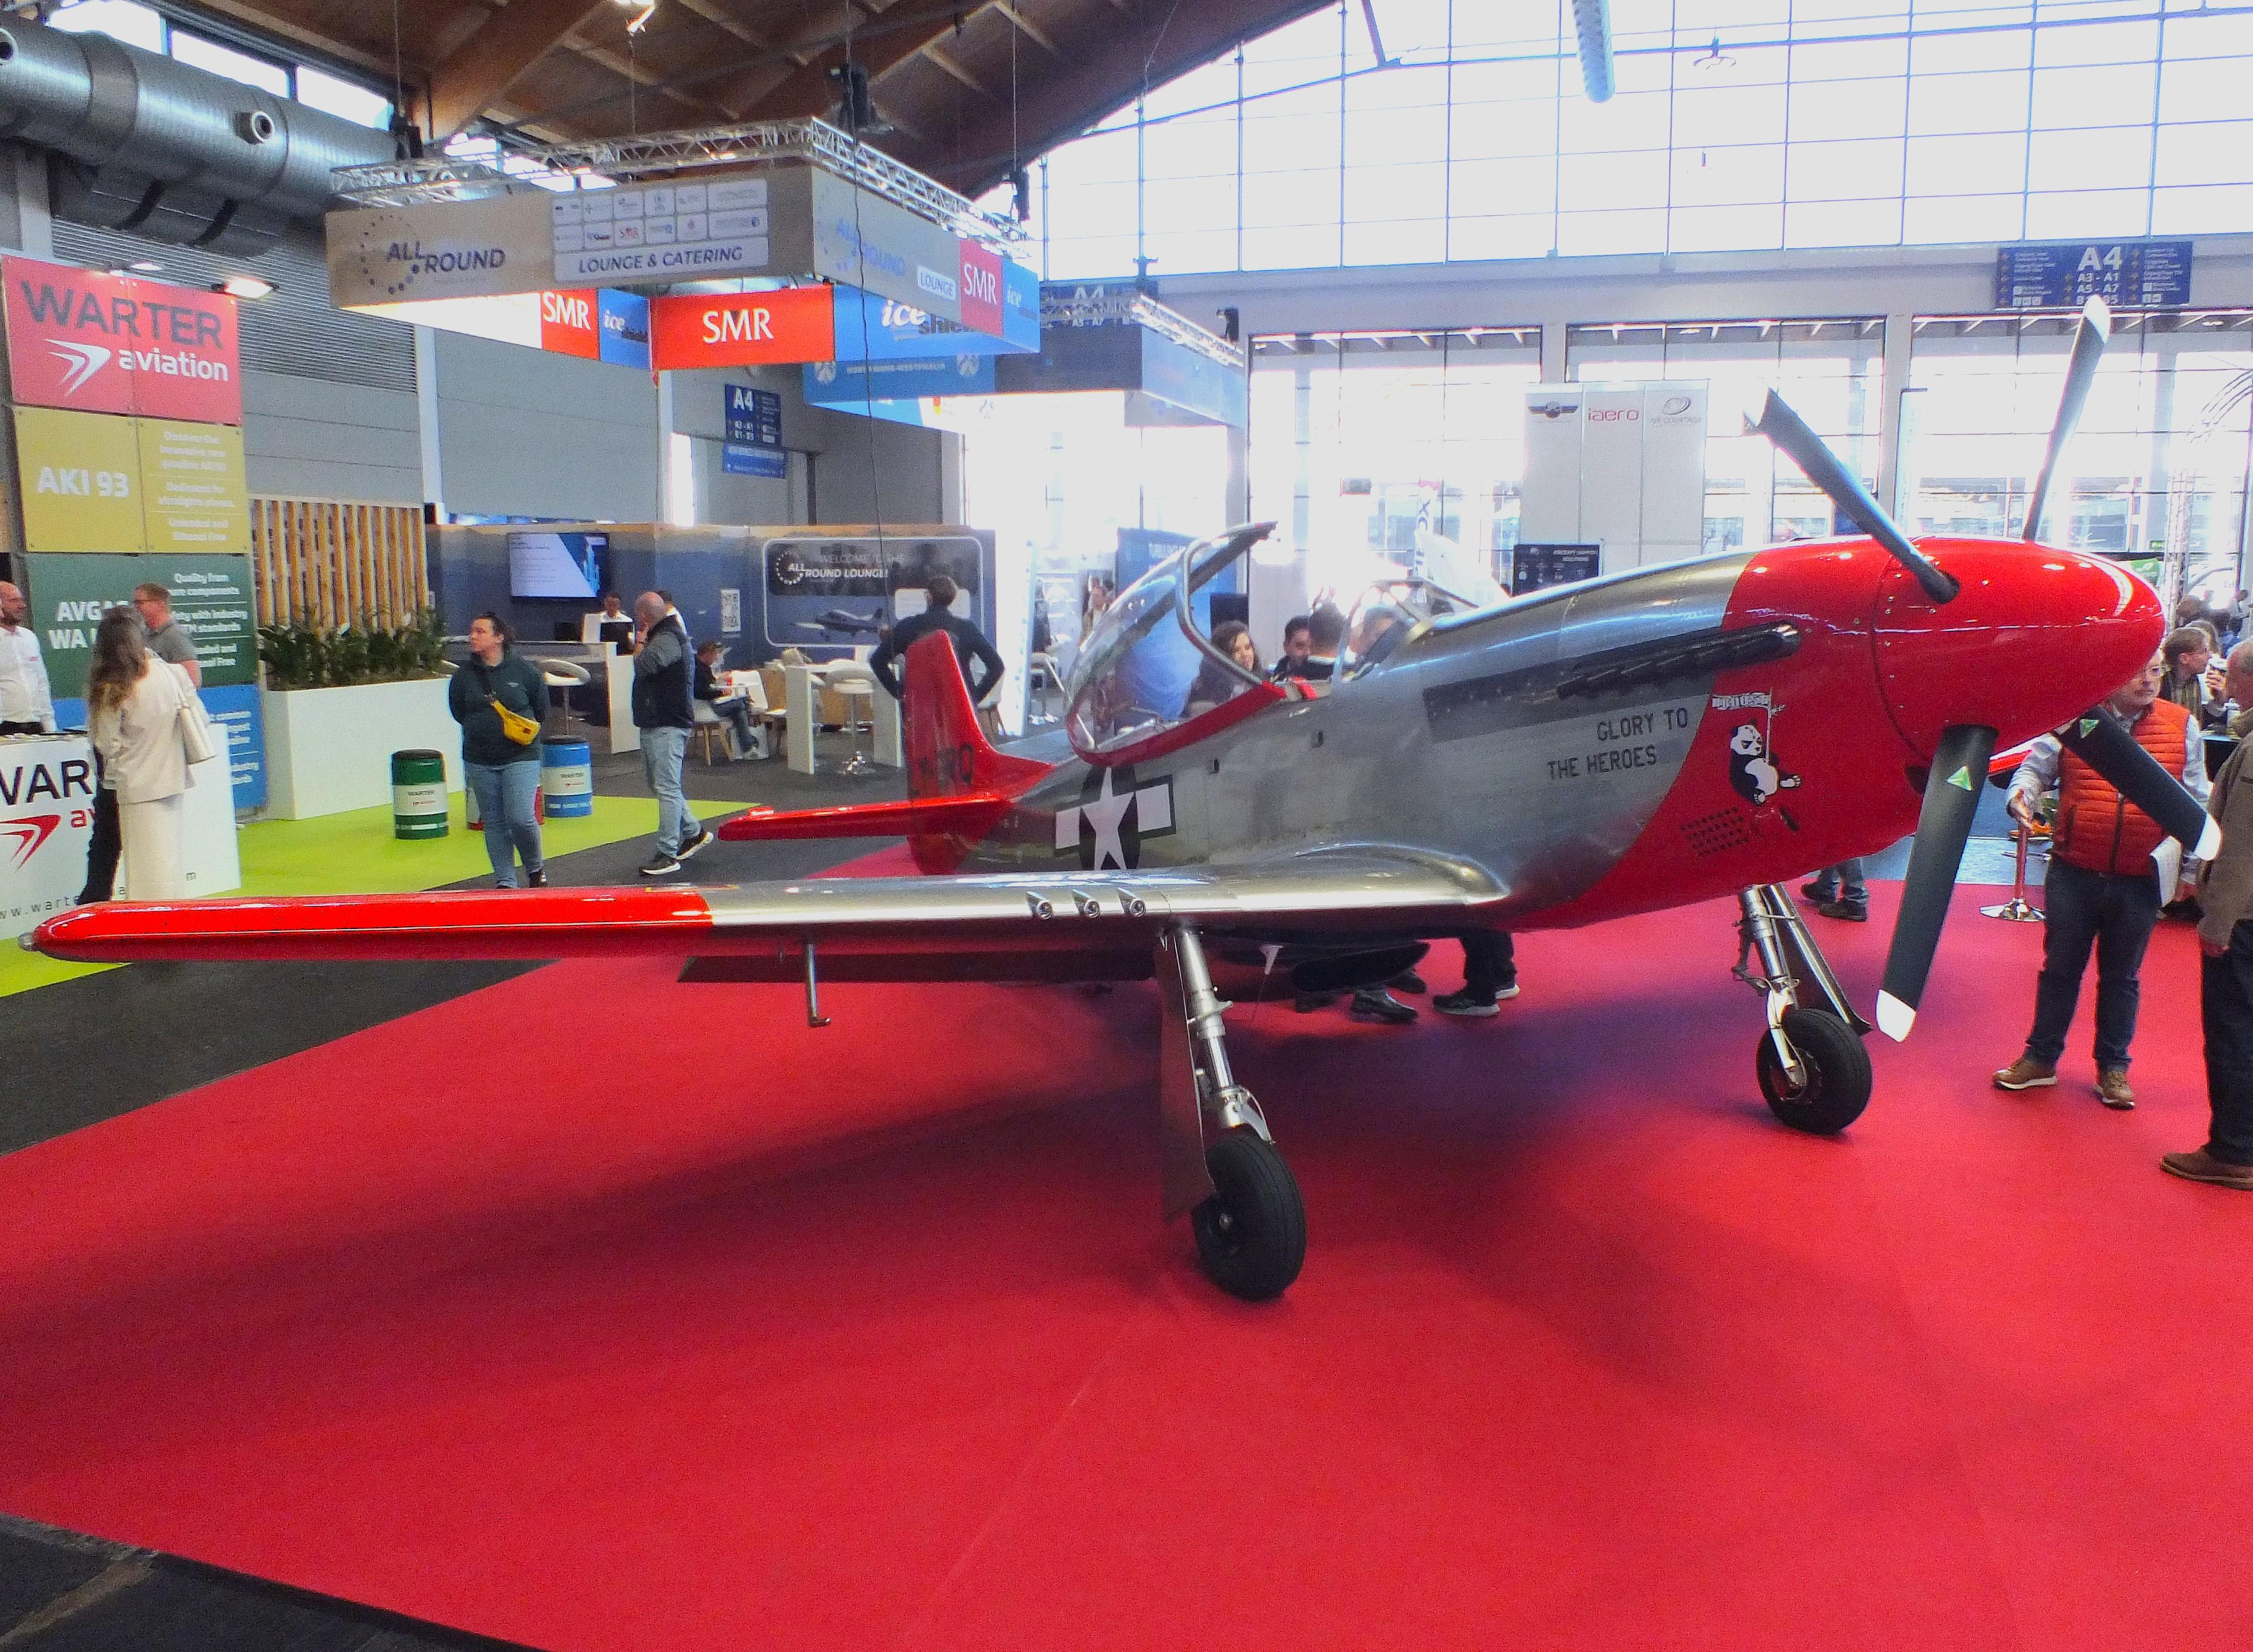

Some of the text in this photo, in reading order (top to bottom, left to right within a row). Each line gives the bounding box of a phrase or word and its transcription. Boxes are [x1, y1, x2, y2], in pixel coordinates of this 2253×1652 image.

[386, 241, 426, 262] ALL
[424, 248, 506, 273] ROUND
[579, 245, 743, 273] LOUNGE & CATERING
[2077, 246, 2123, 271] A4
[920, 271, 955, 298] LOUNGE
[963, 263, 997, 305] SMR
[2077, 284, 2092, 294] A5
[2103, 283, 2119, 293] A7
[2103, 272, 2118, 281] A1
[1006, 284, 1022, 308] ice
[20, 280, 224, 349] WARTER
[542, 291, 592, 330] SMR
[604, 309, 625, 331] ice
[882, 299, 926, 327] ice
[703, 308, 774, 344] SMR
[118, 347, 229, 382] aviation
[734, 387, 754, 412] A4
[1587, 407, 1639, 422] iaero
[37, 466, 130, 498] AKI 93
[787, 563, 806, 572] ALL
[804, 568, 842, 578] ROUND
[57, 601, 130, 622] AVG
[48, 628, 88, 650] WA
[1597, 707, 1688, 741] GLORY TO
[1547, 744, 1657, 779] THE HEROES
